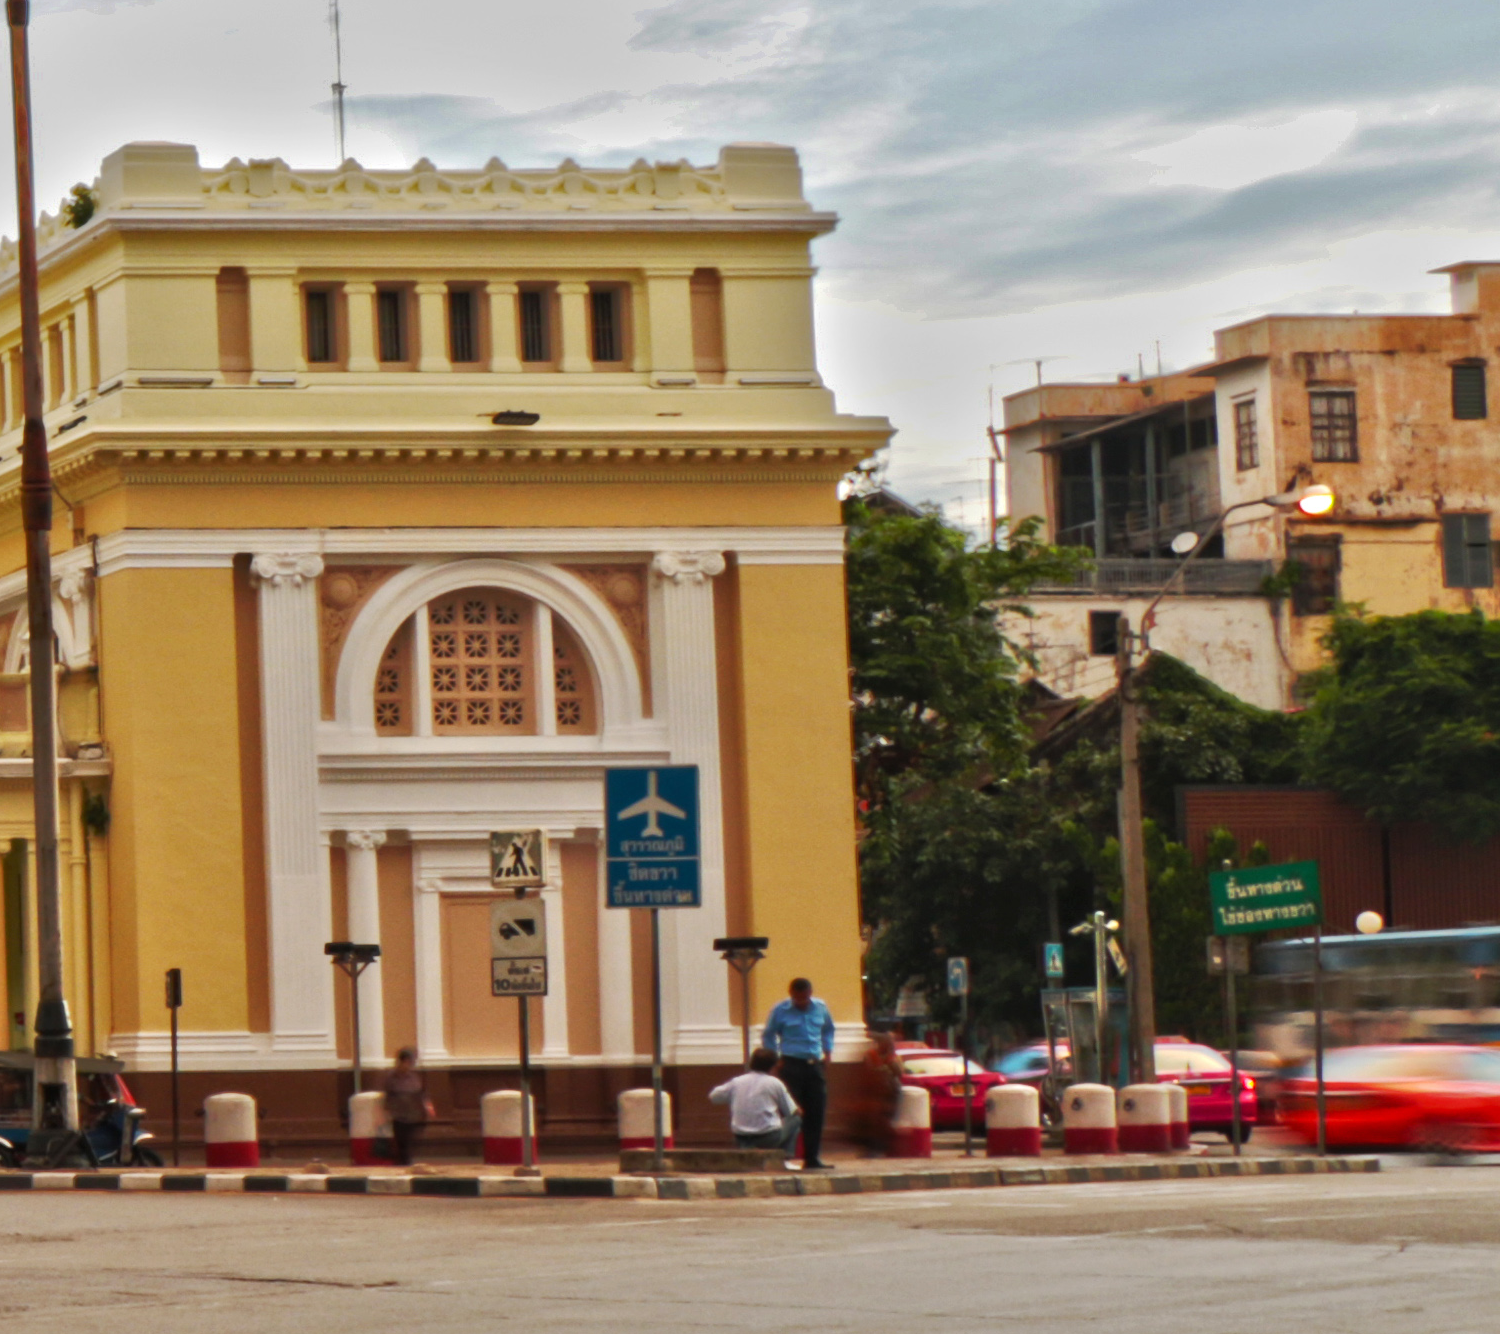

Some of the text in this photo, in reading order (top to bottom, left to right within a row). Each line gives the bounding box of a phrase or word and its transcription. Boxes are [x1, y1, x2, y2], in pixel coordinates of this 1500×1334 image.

[620, 835, 685, 857] สุวรรณภูมิ
[1225, 874, 1305, 900] ขึ้นทางด่วน
